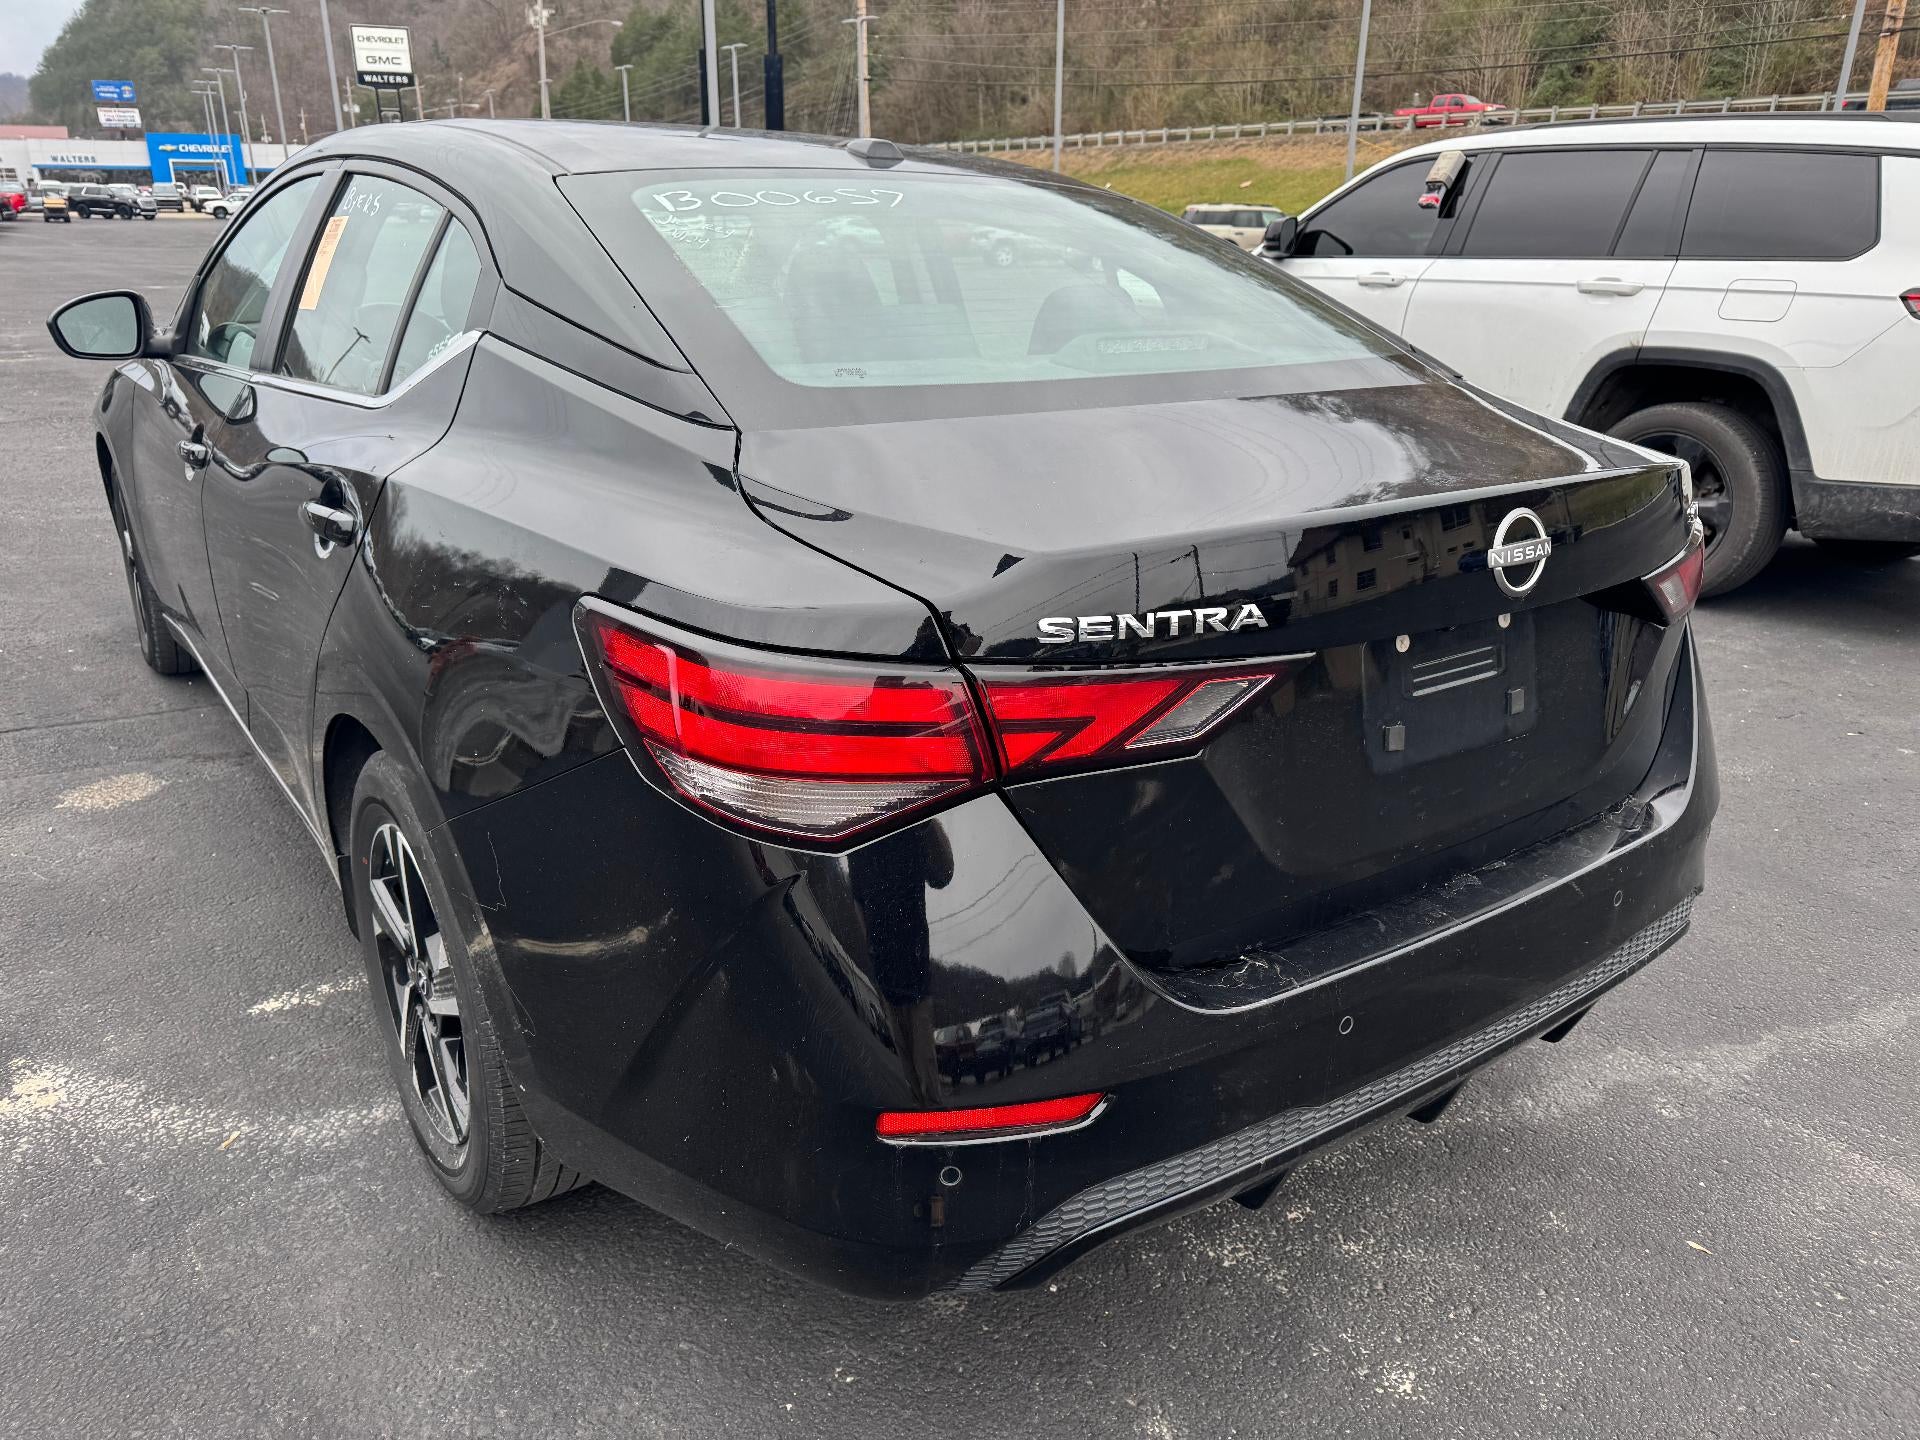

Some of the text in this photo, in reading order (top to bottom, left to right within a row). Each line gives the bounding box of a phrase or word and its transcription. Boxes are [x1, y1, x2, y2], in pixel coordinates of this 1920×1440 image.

[357, 35, 404, 44] CHEVROLET
[366, 55, 402, 65] GMC
[363, 74, 409, 84] WALTERS
[51, 155, 96, 163] WALTERS
[1491, 541, 1552, 566] NISSAN
[1037, 603, 1269, 644] SENTRA
